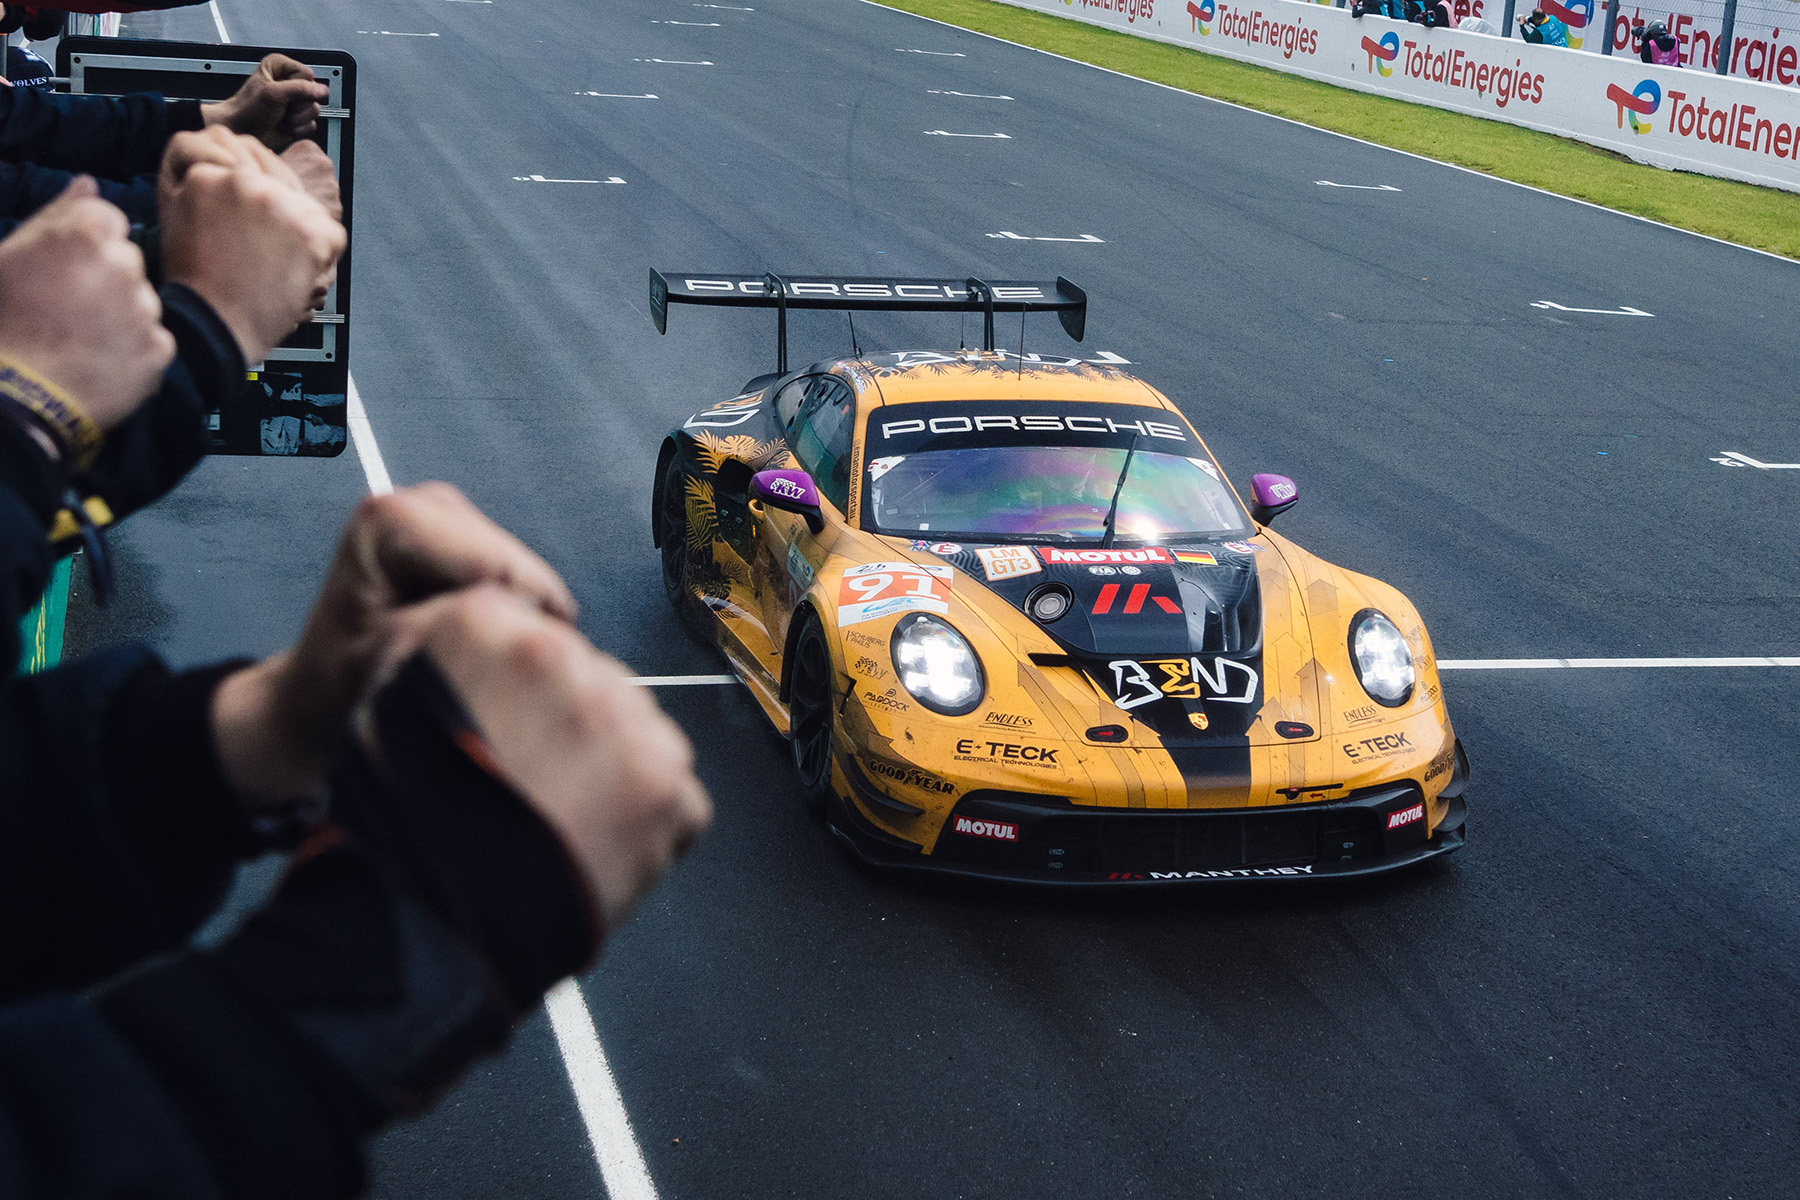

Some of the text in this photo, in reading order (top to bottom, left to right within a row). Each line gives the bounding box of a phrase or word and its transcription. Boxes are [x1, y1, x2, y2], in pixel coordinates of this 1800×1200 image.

[1218, 5, 1318, 59] TotalEnergies
[1404, 40, 1545, 108] TotalEnergies
[685, 279, 1044, 299] PORSCHE
[882, 415, 1187, 441] PORSCHE
[989, 550, 1021, 559] LM
[1050, 549, 1166, 562] MOTUL
[991, 558, 1032, 575] GT3
[848, 573, 942, 602] 91
[864, 691, 910, 712] PADDOCK
[985, 711, 1035, 726] ENDLESS
[1343, 705, 1377, 722] ENDLESS
[954, 755, 1057, 770] ELECTRICAL TECHNOLOGIES
[1388, 804, 1423, 828] MOTUL
[956, 818, 1016, 840] MOTUL
[1149, 865, 1313, 880] MANTHEY
